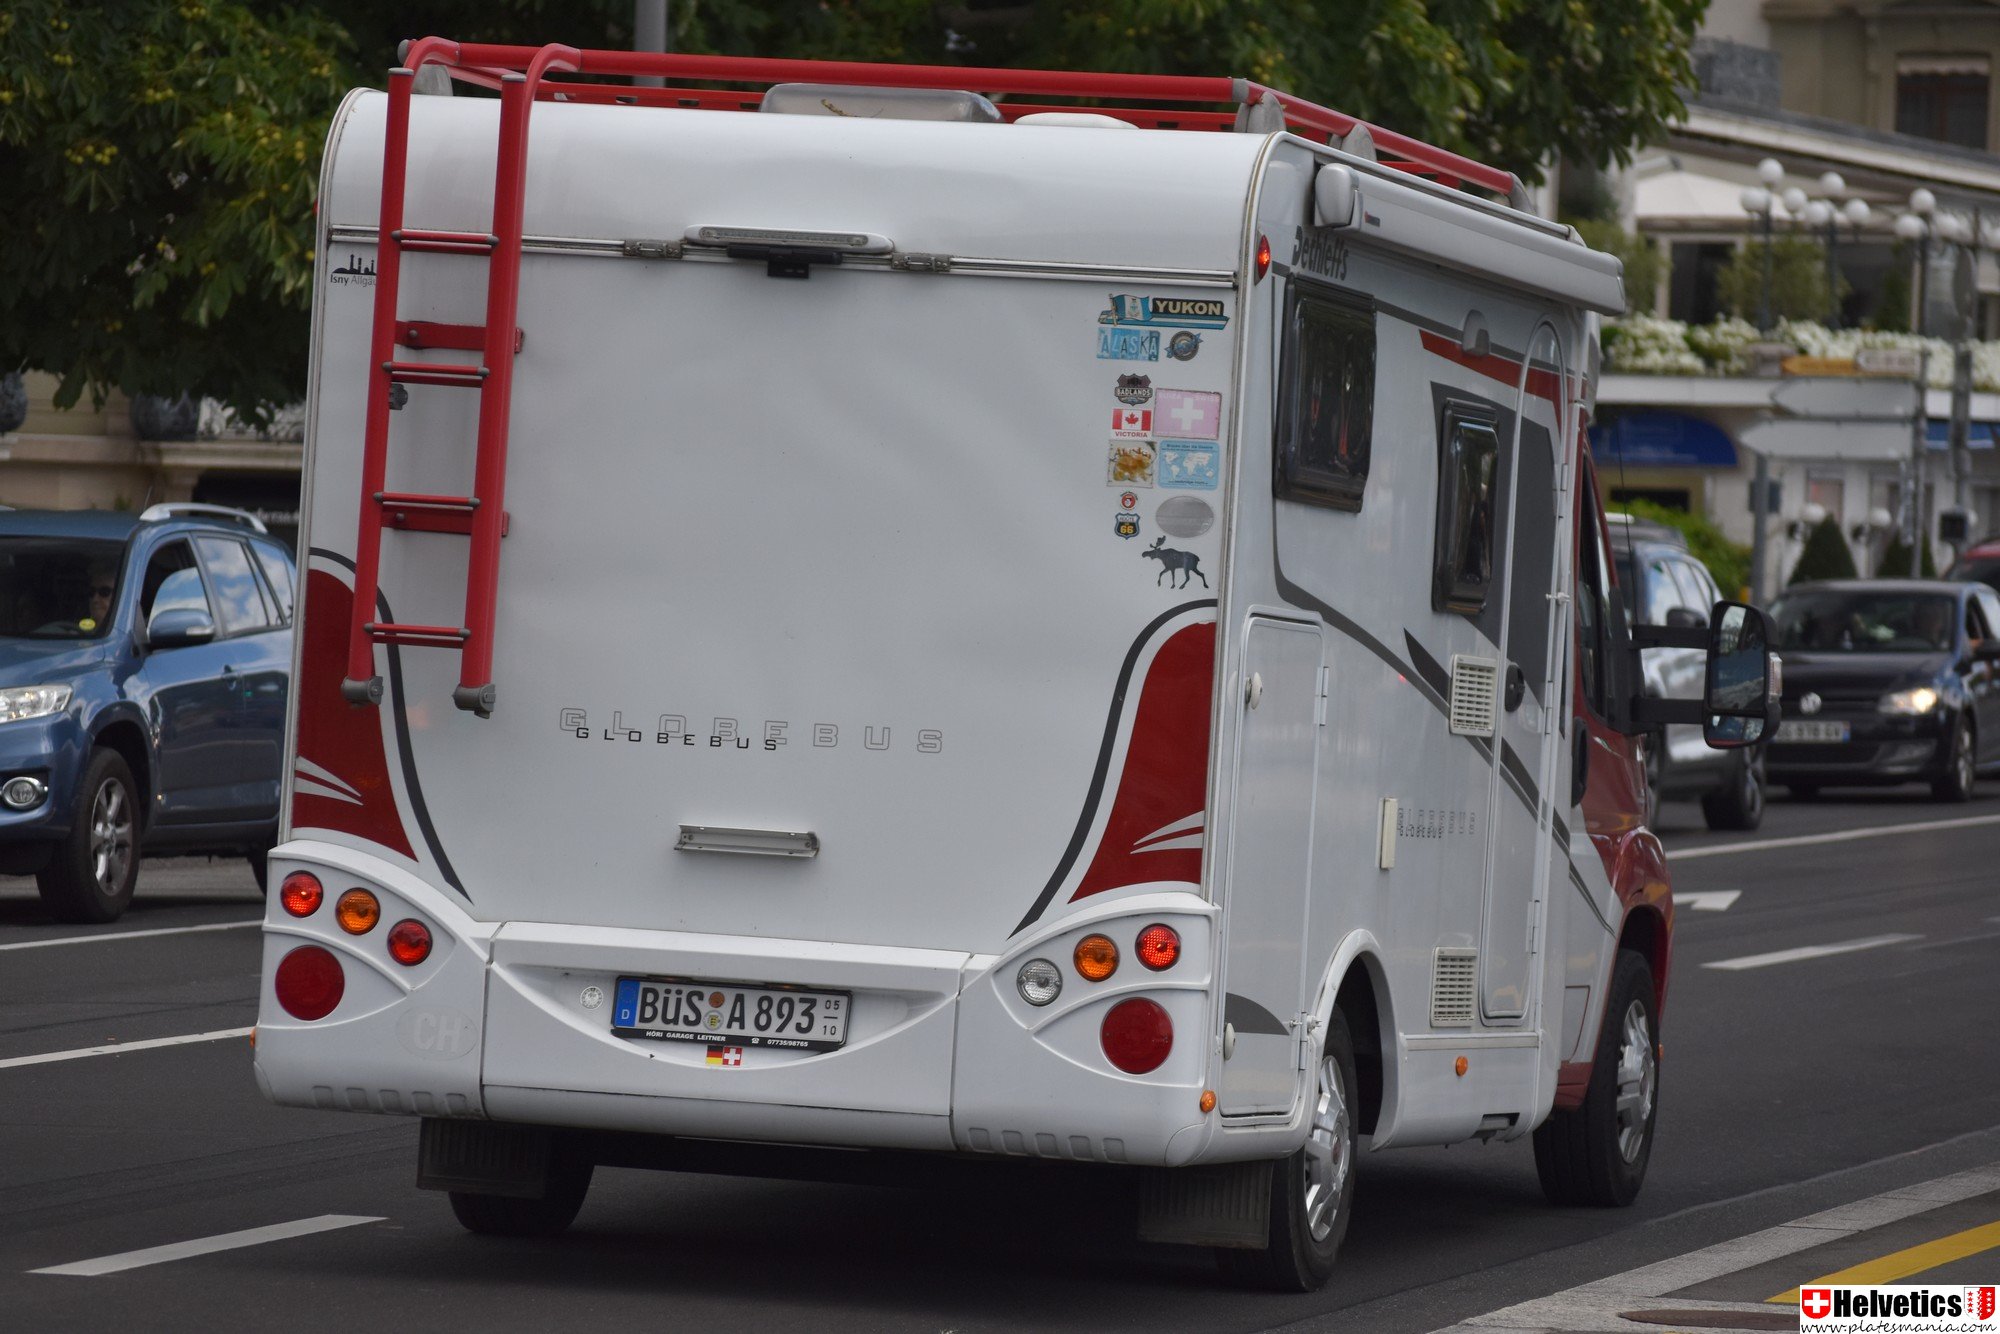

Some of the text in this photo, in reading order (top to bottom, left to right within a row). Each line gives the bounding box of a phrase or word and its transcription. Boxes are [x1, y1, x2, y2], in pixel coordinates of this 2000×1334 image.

[330, 274, 349, 286] Isny
[1156, 300, 1221, 315] YUKON
[1101, 333, 1158, 355] ALASKA
[1120, 525, 1134, 534] 66
[559, 707, 943, 754] GLOBEBUS
[575, 727, 777, 752] GLOBEBUS
[825, 999, 840, 1011] 05
[621, 1009, 630, 1020] D
[726, 993, 746, 1031] A
[754, 995, 818, 1034] 893
[414, 1012, 462, 1052] CH
[646, 1030, 809, 1047] HÖRI GARAGE LEITNER 07735/98765
[823, 1025, 837, 1036] 10
